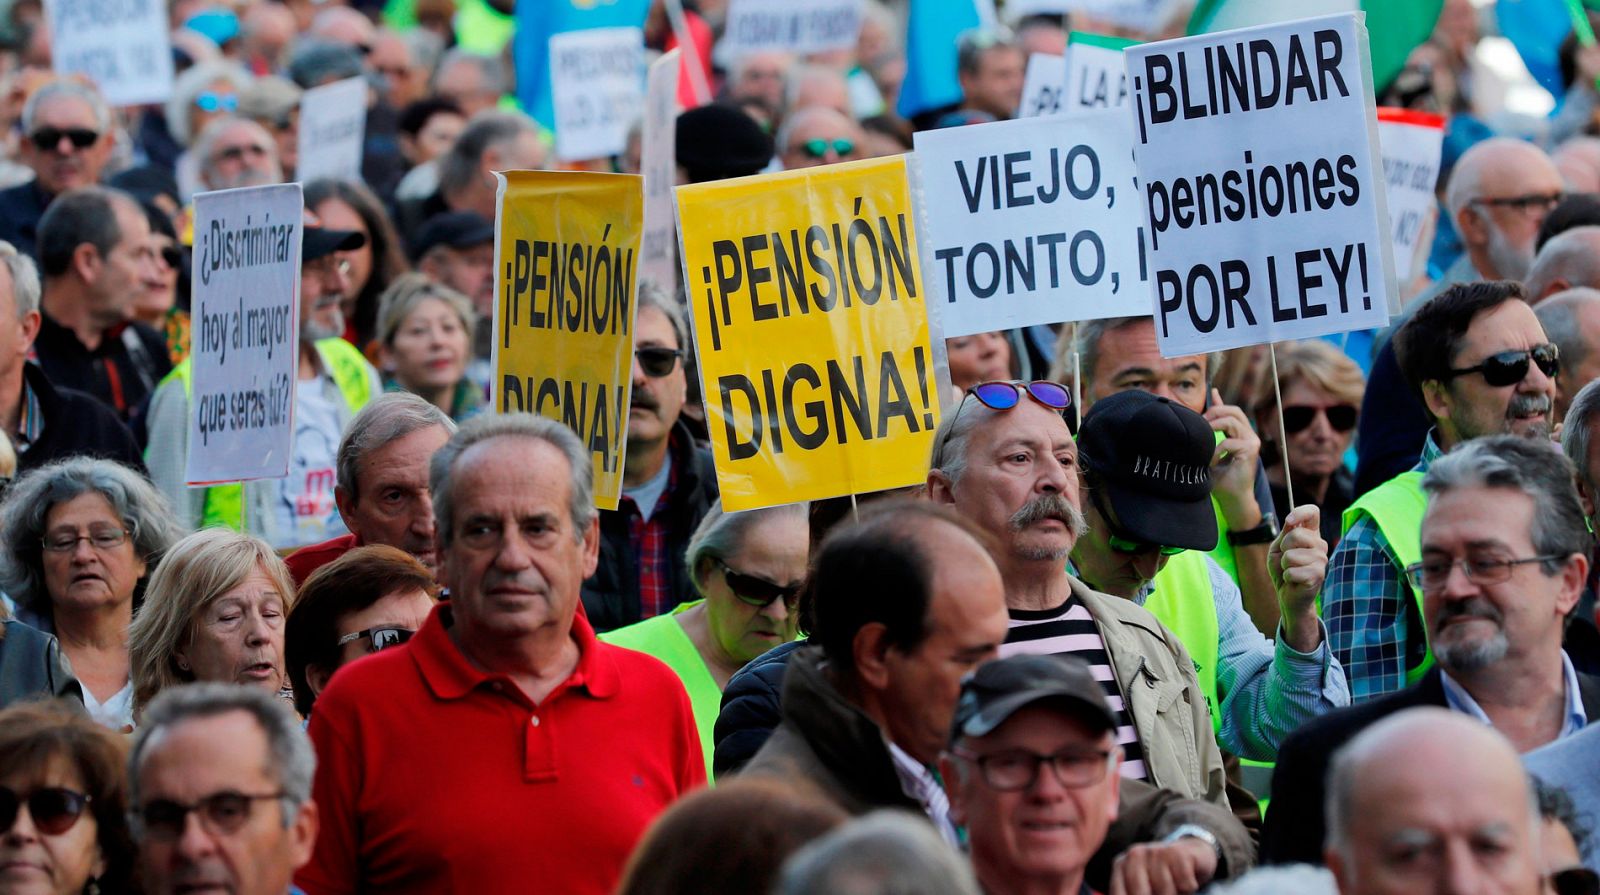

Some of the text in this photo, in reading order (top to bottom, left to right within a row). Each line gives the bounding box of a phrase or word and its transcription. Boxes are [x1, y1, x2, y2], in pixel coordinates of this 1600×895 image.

[1080, 65, 1108, 108] LA
[1135, 29, 1350, 144] ¡BLINDAR
[954, 144, 1115, 214] VIEJO,
[1147, 150, 1360, 251] pensiones
[504, 223, 633, 349] ¡PENSIÓN
[702, 196, 917, 351] ¡PENSIÓN
[935, 229, 1120, 303] TONTO,
[1156, 242, 1372, 338] POR LEY!
[201, 297, 289, 365] hoy al mayor
[199, 373, 289, 446] que serás tú?
[718, 346, 935, 461] DIGNA!
